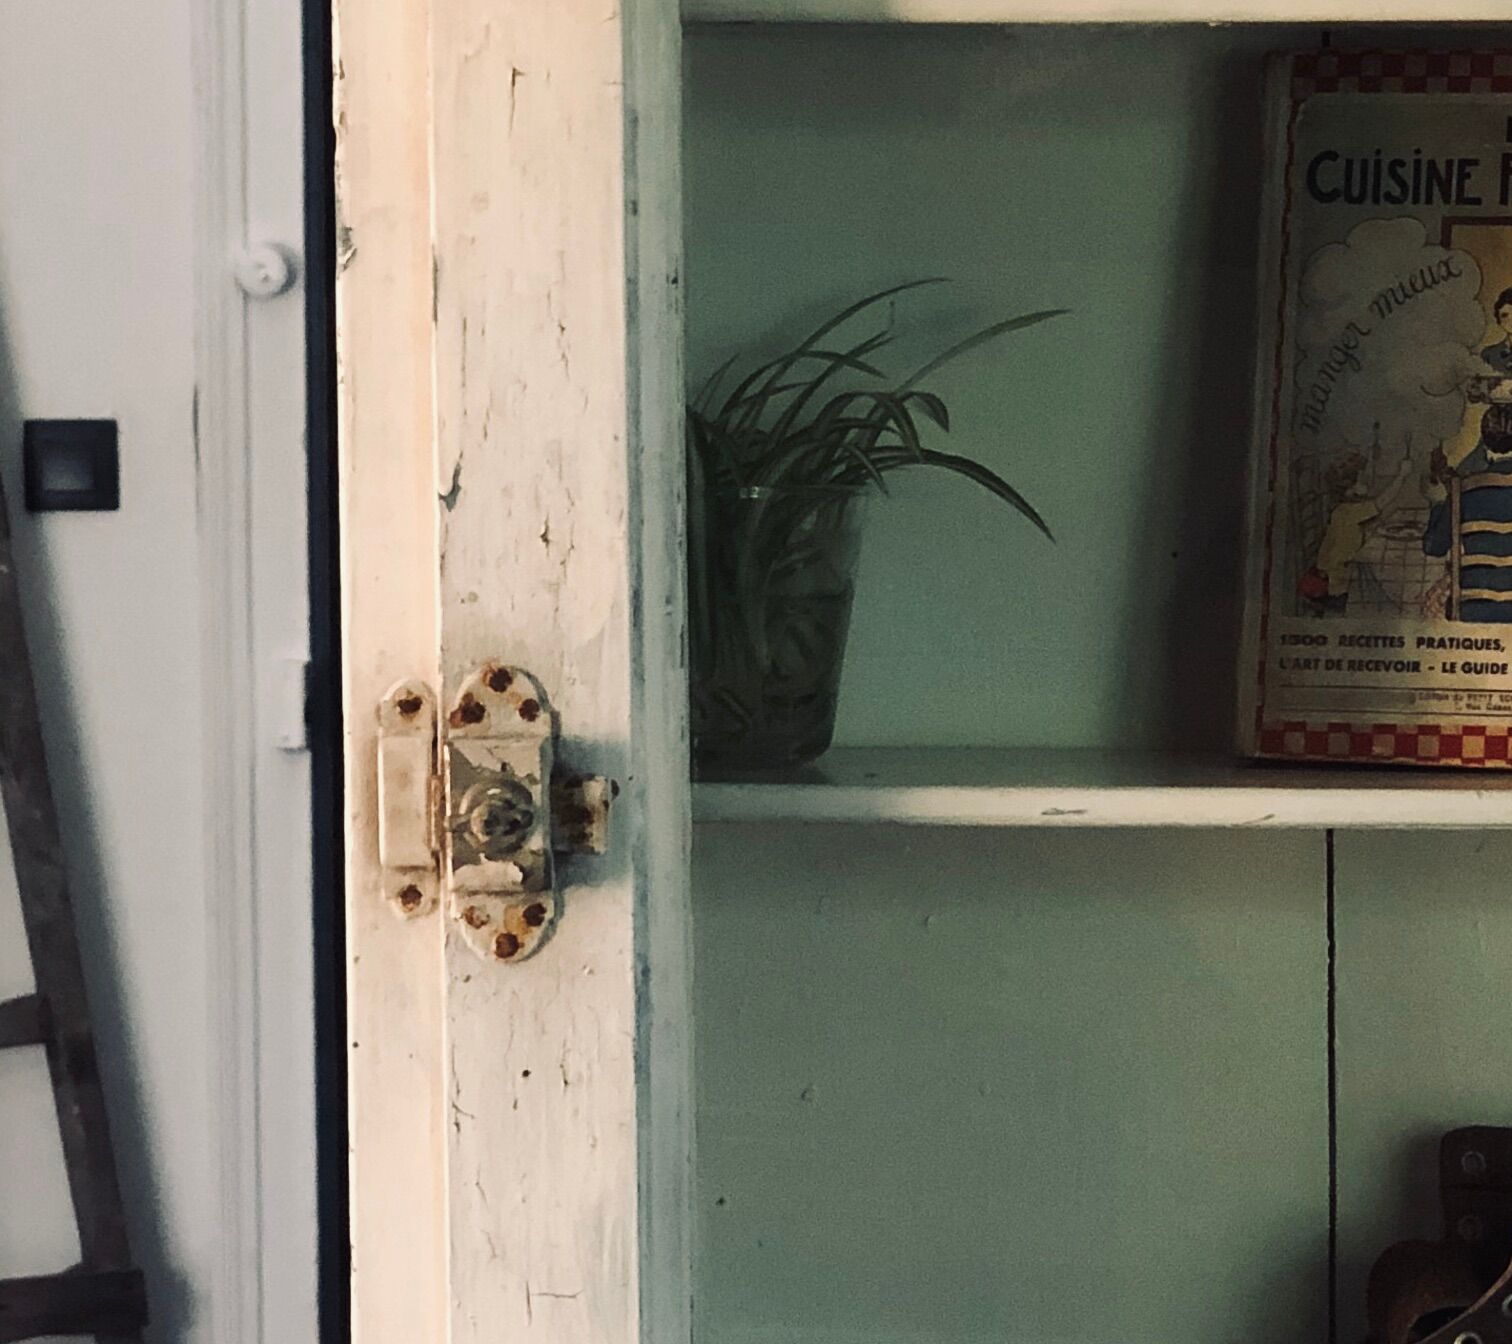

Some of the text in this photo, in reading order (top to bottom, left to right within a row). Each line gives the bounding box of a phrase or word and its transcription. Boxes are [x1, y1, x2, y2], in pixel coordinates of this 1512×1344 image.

[1306, 148, 1482, 207] CUISINE
[1300, 256, 1463, 434] manger mieux
[1338, 635, 1405, 649] RECETTES
[1416, 636, 1506, 653] PRATIQUES,
[1325, 659, 1343, 671] DE
[1347, 659, 1421, 673] RECEVOIR
[1441, 661, 1456, 674] LE
[1461, 661, 1508, 675] GUIDE
